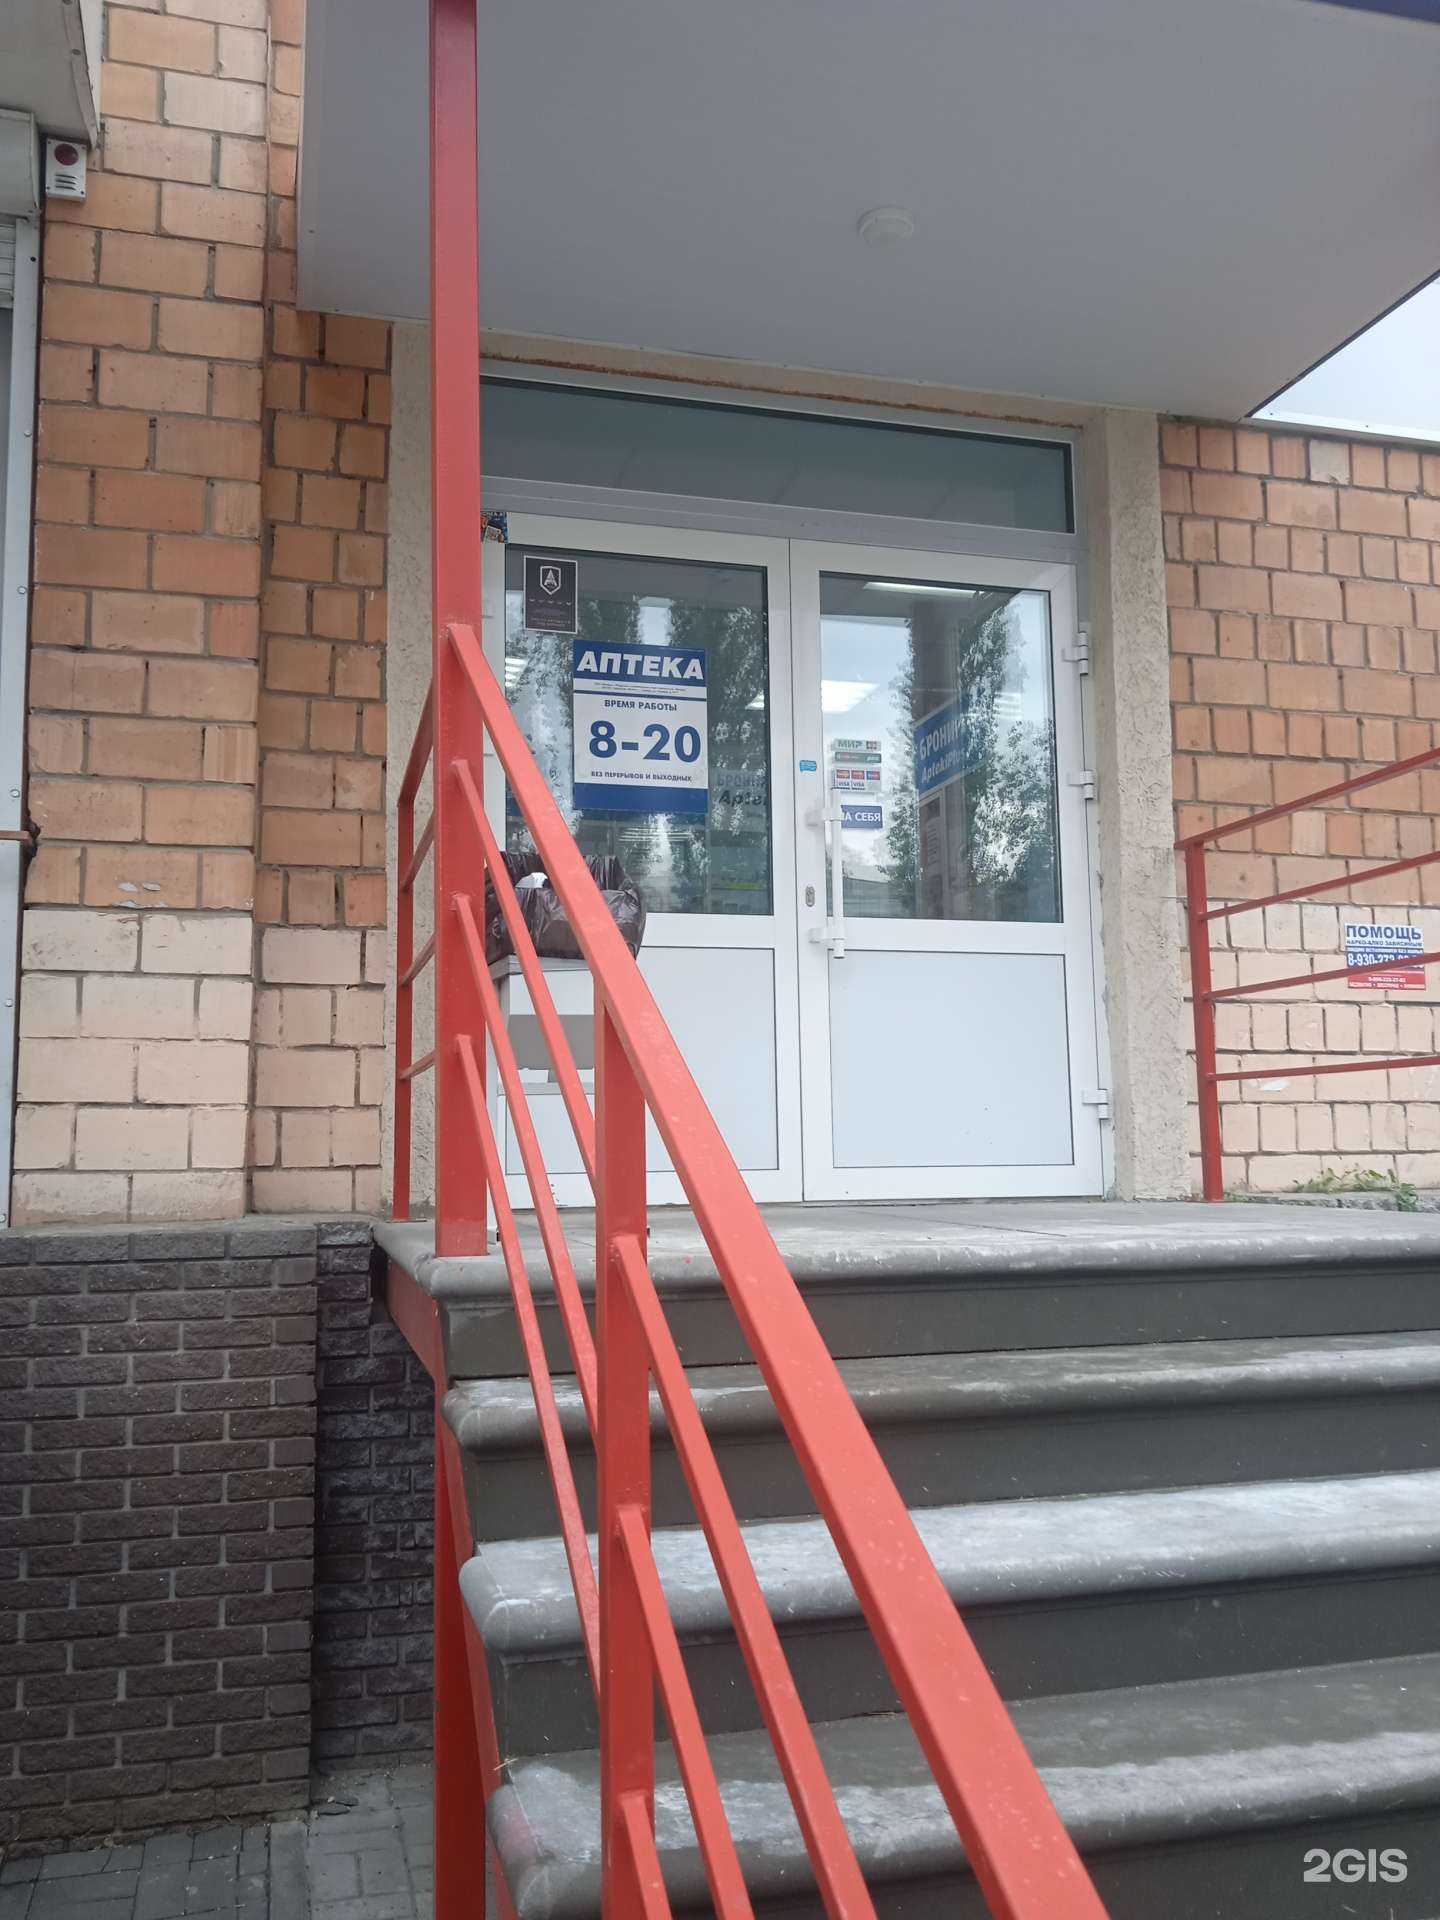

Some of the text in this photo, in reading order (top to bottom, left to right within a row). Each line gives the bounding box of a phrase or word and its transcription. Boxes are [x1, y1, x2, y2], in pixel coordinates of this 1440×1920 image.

[576, 650, 704, 681] АПТЕКА
[604, 699, 678, 712] ВРЕМЯ РАБОТЫ
[589, 720, 701, 763] 8-20
[591, 770, 603, 778] БЕЗ
[604, 771, 644, 780] ПЕРЕРЫВОВ
[652, 774, 693, 782] ВЫХОДНЫХ
[854, 811, 881, 823] СЕБЯ
[1346, 925, 1422, 942] ПОМОЩЬ
